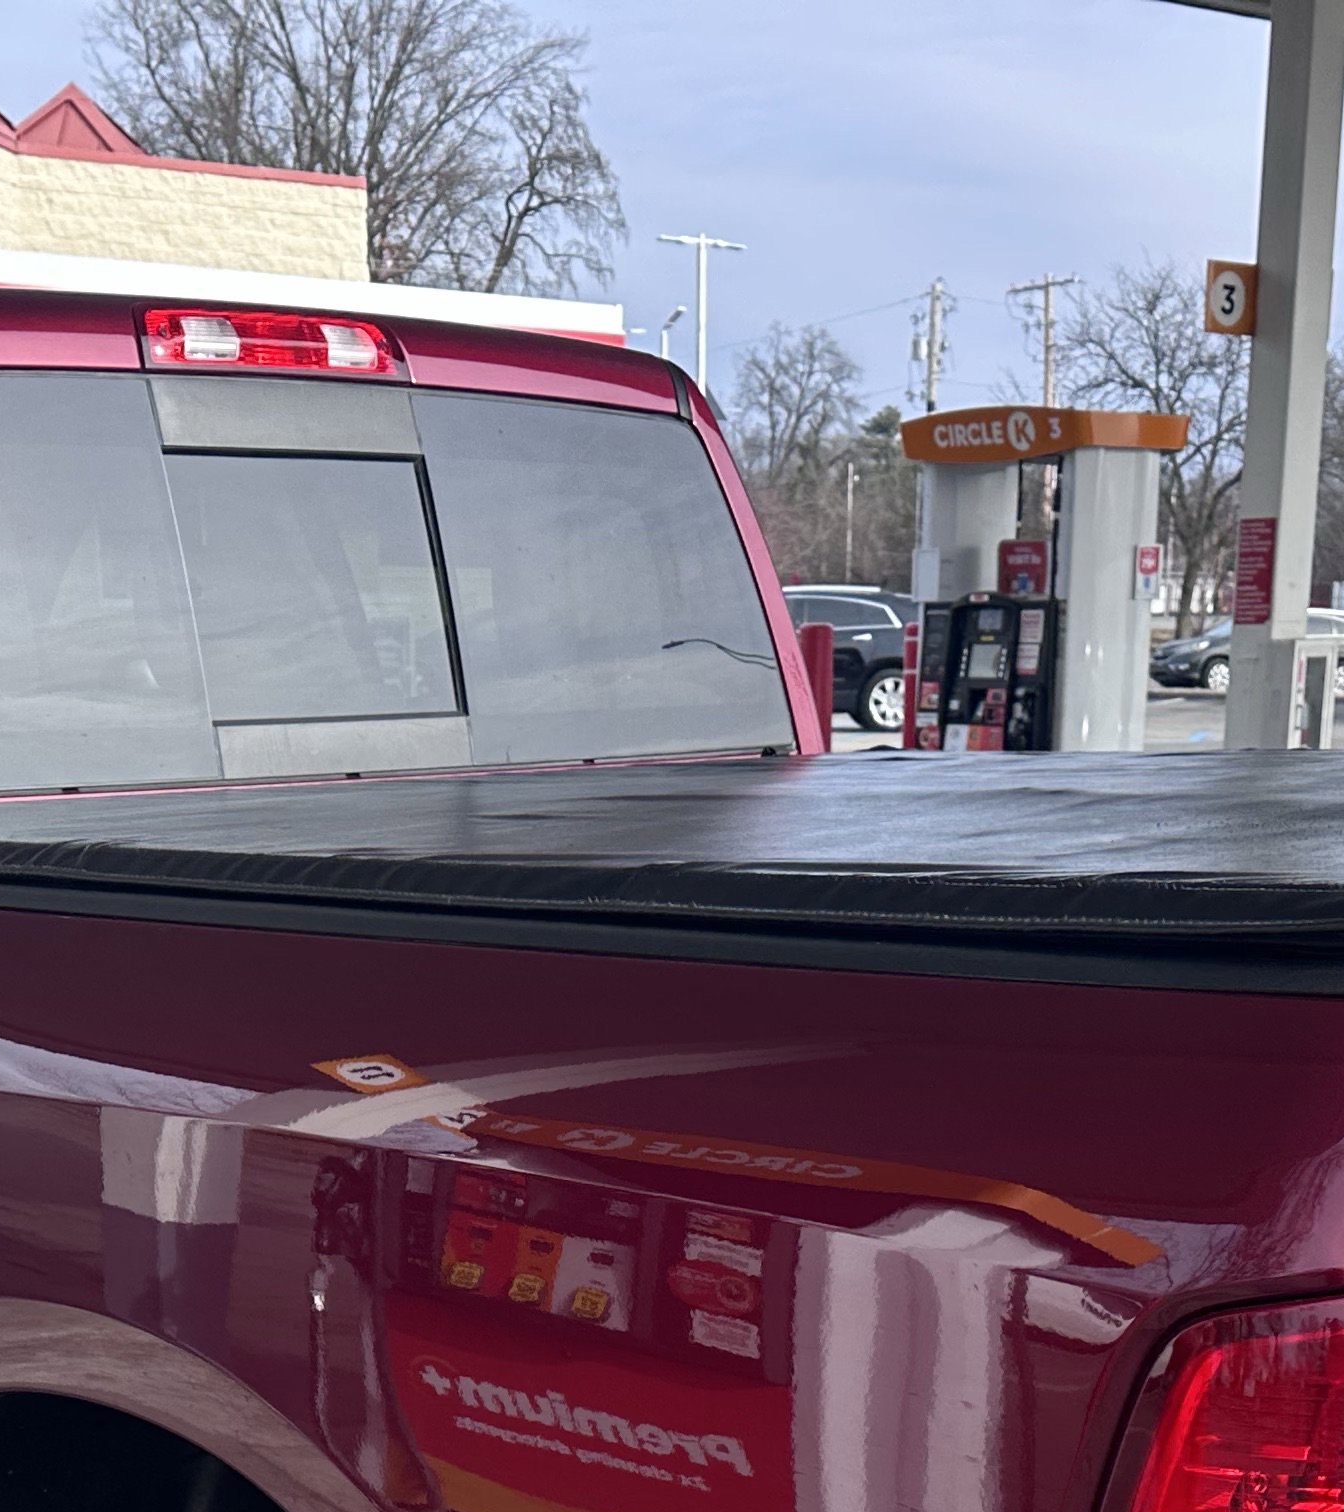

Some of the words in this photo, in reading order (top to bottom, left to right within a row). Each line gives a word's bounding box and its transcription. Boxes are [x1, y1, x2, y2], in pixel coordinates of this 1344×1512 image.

[1220, 284, 1236, 315] 3
[933, 421, 1005, 449] CIRCLE
[1047, 417, 1062, 439] 3
